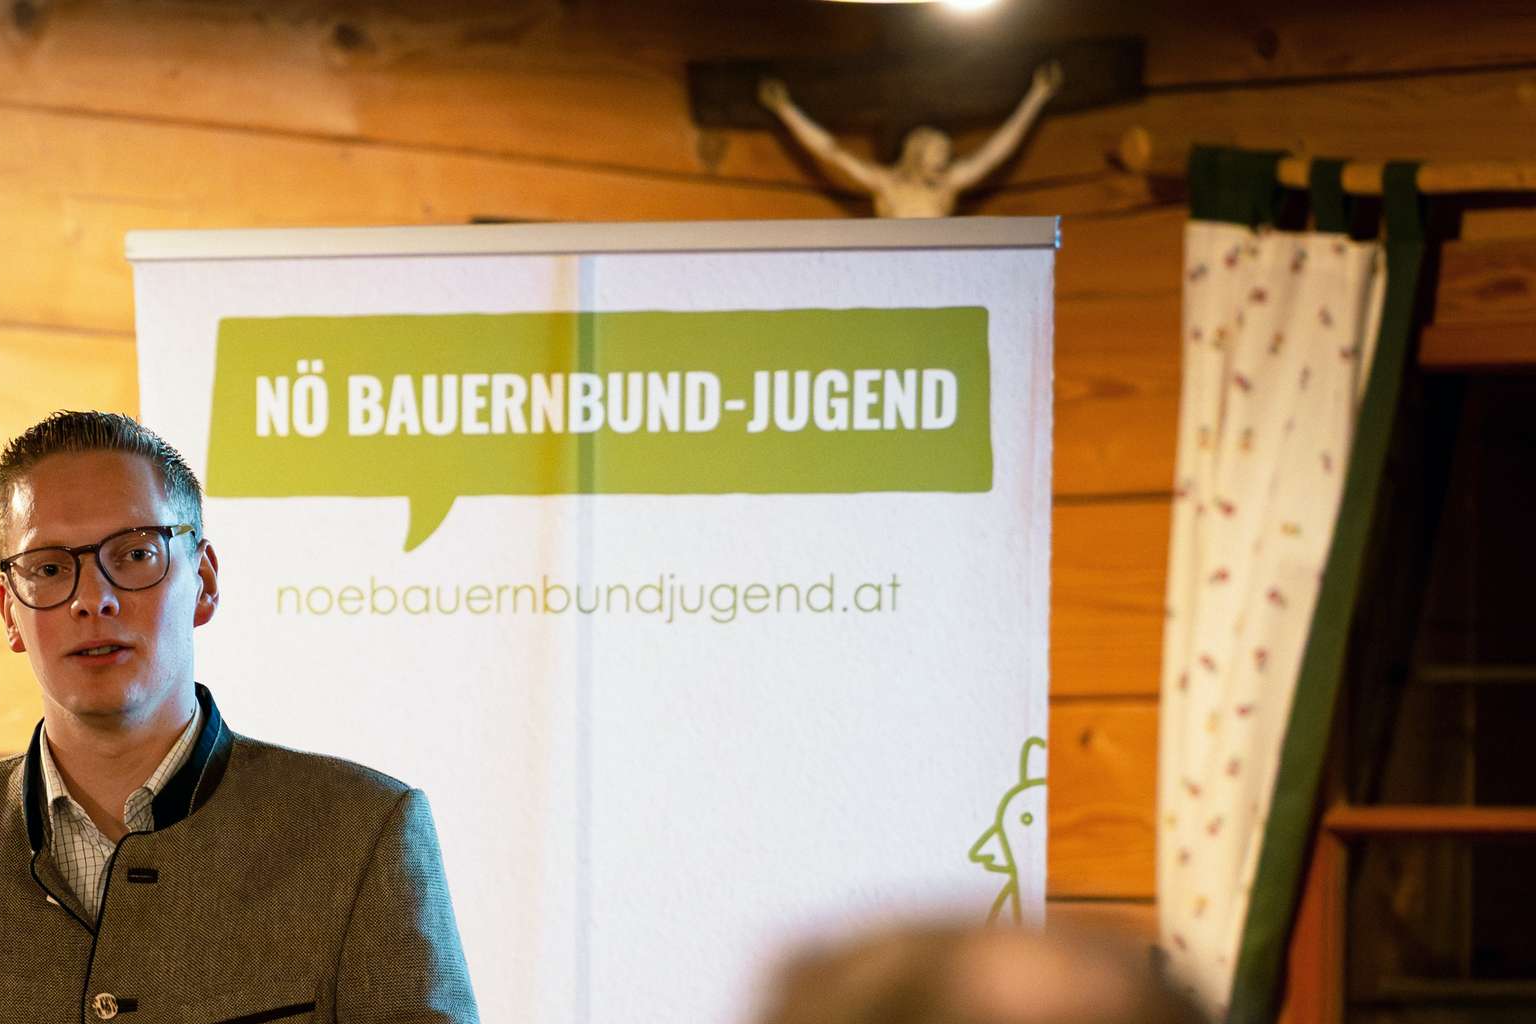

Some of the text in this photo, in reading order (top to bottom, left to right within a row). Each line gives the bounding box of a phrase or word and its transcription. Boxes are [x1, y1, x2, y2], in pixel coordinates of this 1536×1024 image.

[254, 360, 959, 437] NÖ BAUERNBUND-JUGEND
[276, 572, 902, 624] noebauernbundjugend.at
